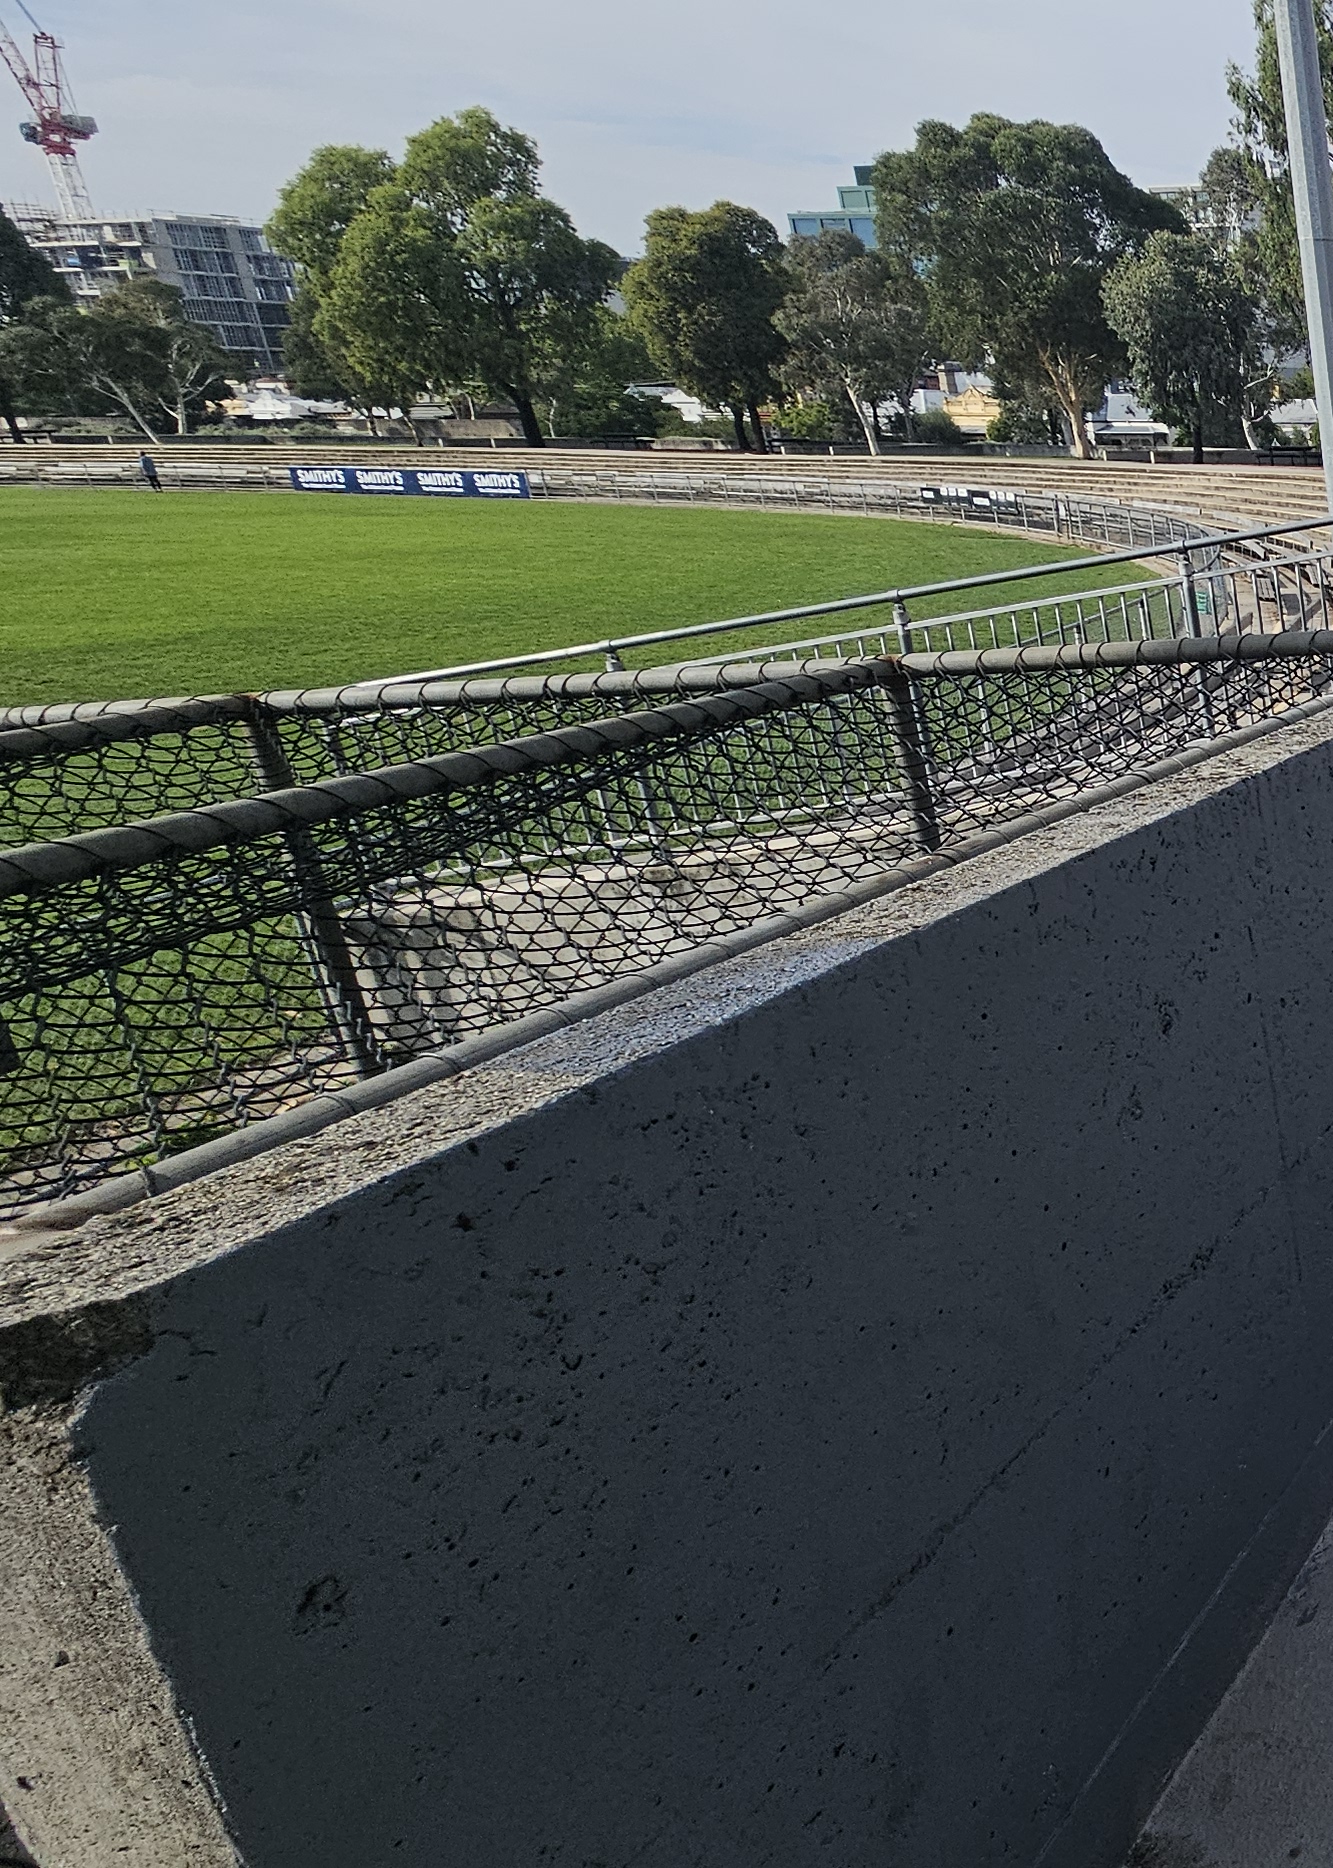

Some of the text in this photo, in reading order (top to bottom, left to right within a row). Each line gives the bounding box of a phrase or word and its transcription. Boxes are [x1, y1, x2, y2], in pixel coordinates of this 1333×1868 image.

[296, 469, 345, 483] SMITHY'S
[355, 470, 404, 485] SMITHY'S
[416, 472, 463, 486] SMITHY'S
[473, 473, 520, 487] SMITHY'S
